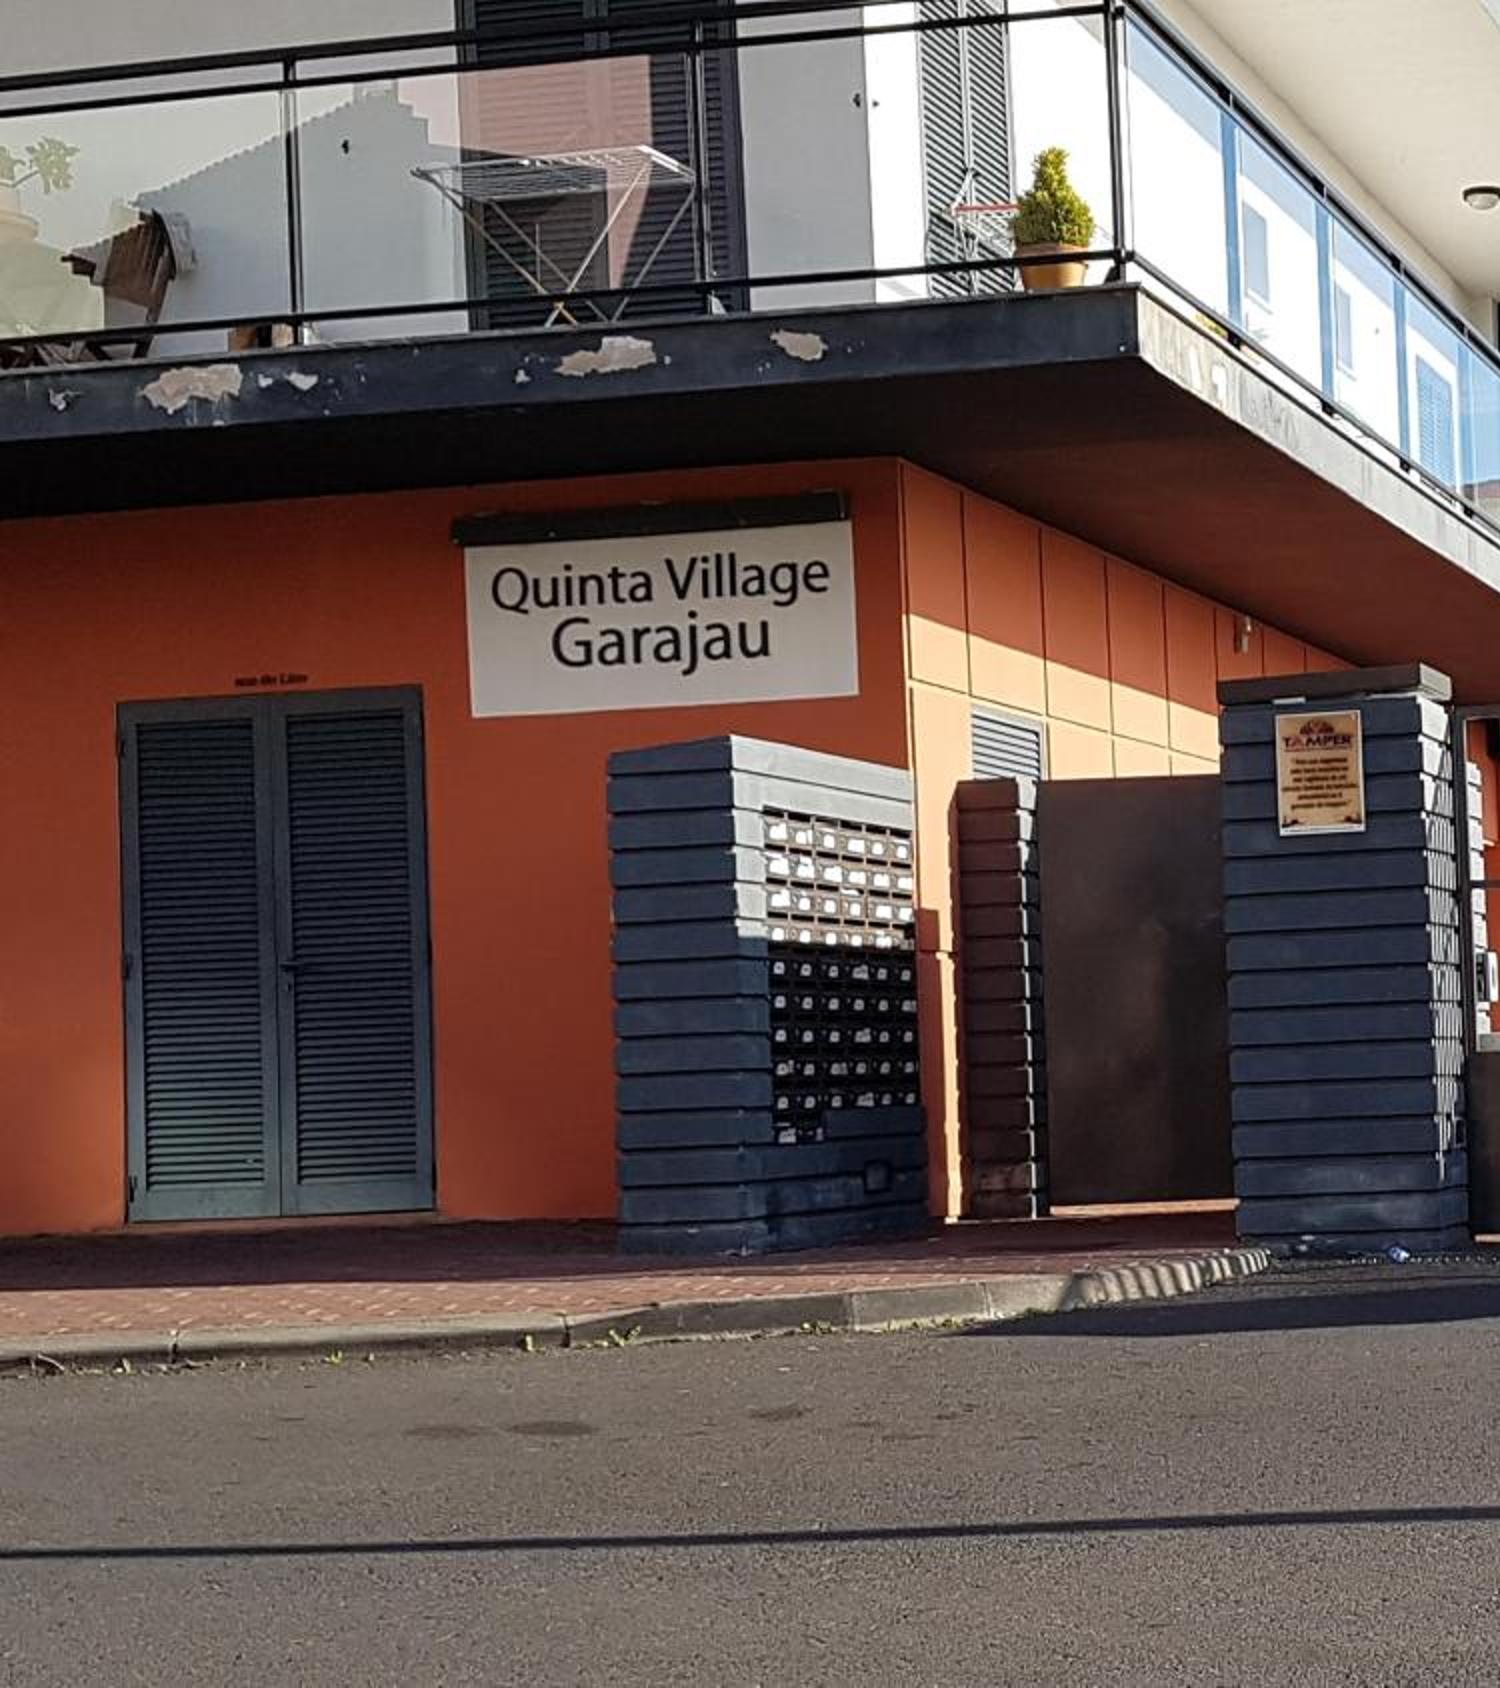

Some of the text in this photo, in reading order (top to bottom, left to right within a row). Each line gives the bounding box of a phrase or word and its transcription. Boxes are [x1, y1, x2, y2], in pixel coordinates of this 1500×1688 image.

[491, 551, 831, 615] Quinta Village
[551, 610, 770, 676] Garajau
